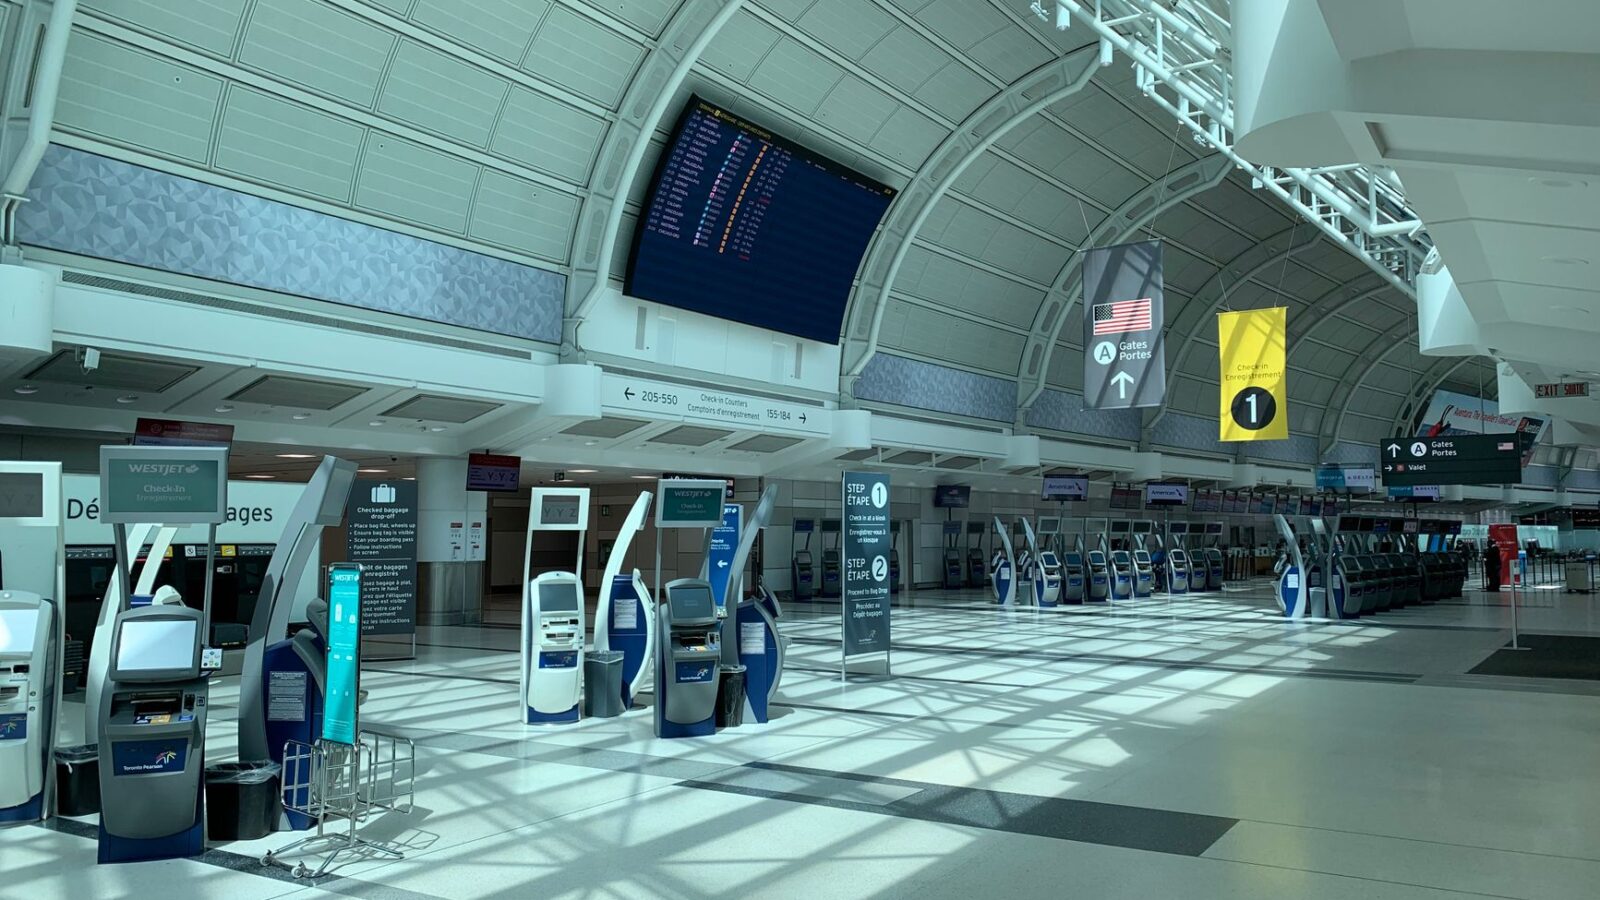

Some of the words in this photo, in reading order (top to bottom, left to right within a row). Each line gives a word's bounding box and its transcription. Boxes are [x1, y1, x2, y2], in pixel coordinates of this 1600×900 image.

[1099, 344, 1112, 360] A
[1120, 341, 1148, 350] Gates
[1120, 351, 1152, 360] Portes
[1225, 372, 1280, 381] Enregistrement
[1537, 384, 1558, 396] EXIT
[642, 391, 678, 405] 205-550
[725, 398, 748, 408] Counters
[688, 404, 716, 415] Comptoirs
[1245, 394, 1257, 423] 1
[767, 409, 791, 420] 155-184
[1414, 444, 1424, 454] A
[128, 464, 185, 476] WESTJET
[847, 484, 865, 493] STEP
[847, 494, 870, 506] ÉTAPE
[877, 486, 881, 504] 1
[227, 507, 273, 525] ages
[848, 558, 866, 568] STEP
[848, 569, 870, 581] ÉTAPE
[876, 559, 884, 576] 2
